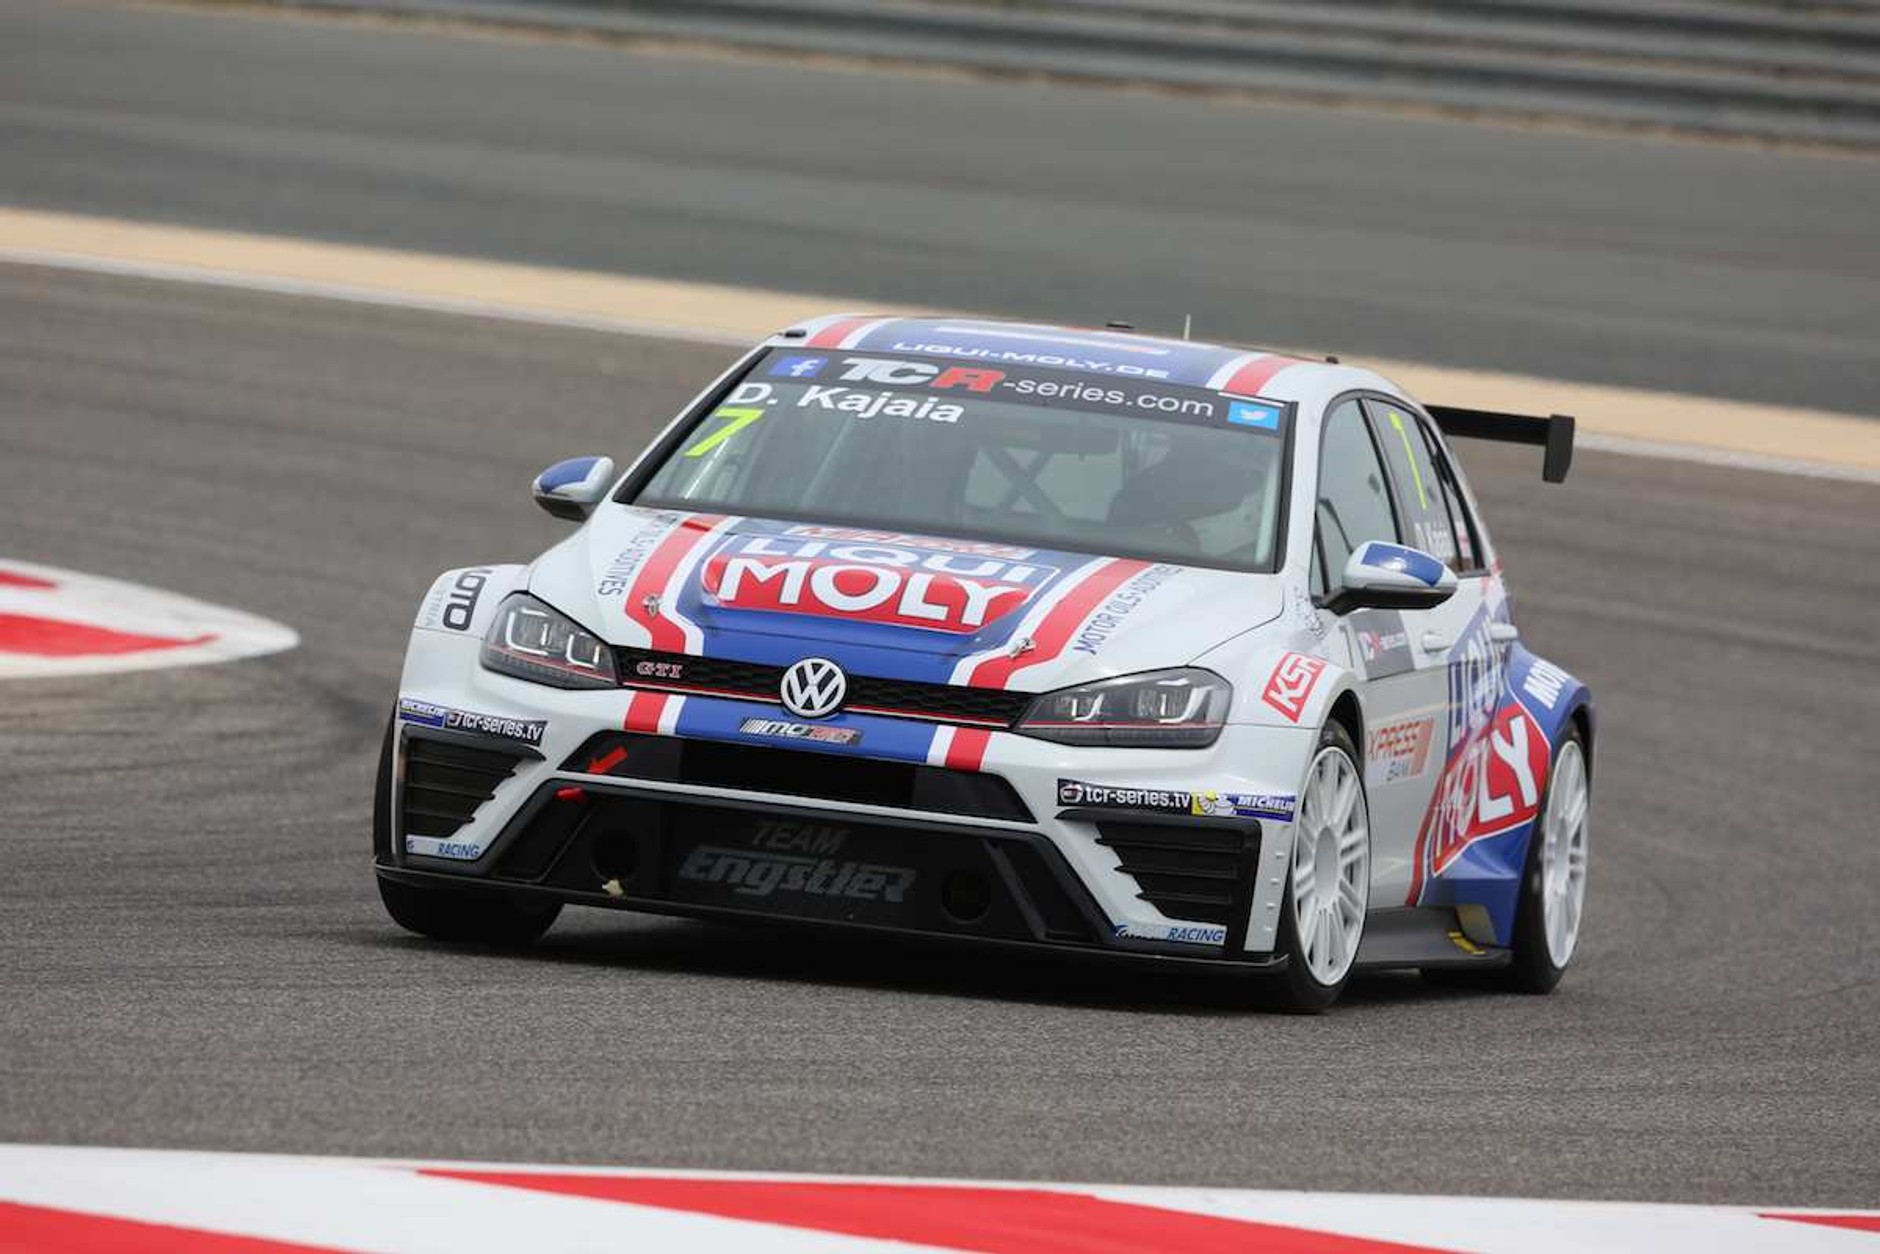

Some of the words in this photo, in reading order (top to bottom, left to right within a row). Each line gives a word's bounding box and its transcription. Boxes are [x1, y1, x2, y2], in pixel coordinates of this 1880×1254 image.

[892, 341, 1170, 379] LIQUI-MOLY.DE
[727, 382, 778, 405] D.
[797, 385, 965, 423] Kajaia
[684, 408, 763, 457] 7
[740, 538, 1034, 582] LIQUI
[717, 557, 1026, 627] MOLY
[636, 660, 682, 679] GTI
[461, 711, 543, 741] tcr-series.tv
[1085, 786, 1191, 809] tcr-series.tv
[438, 841, 480, 858] RACING
[752, 822, 850, 854] TEAM
[1167, 927, 1224, 942] RACING
